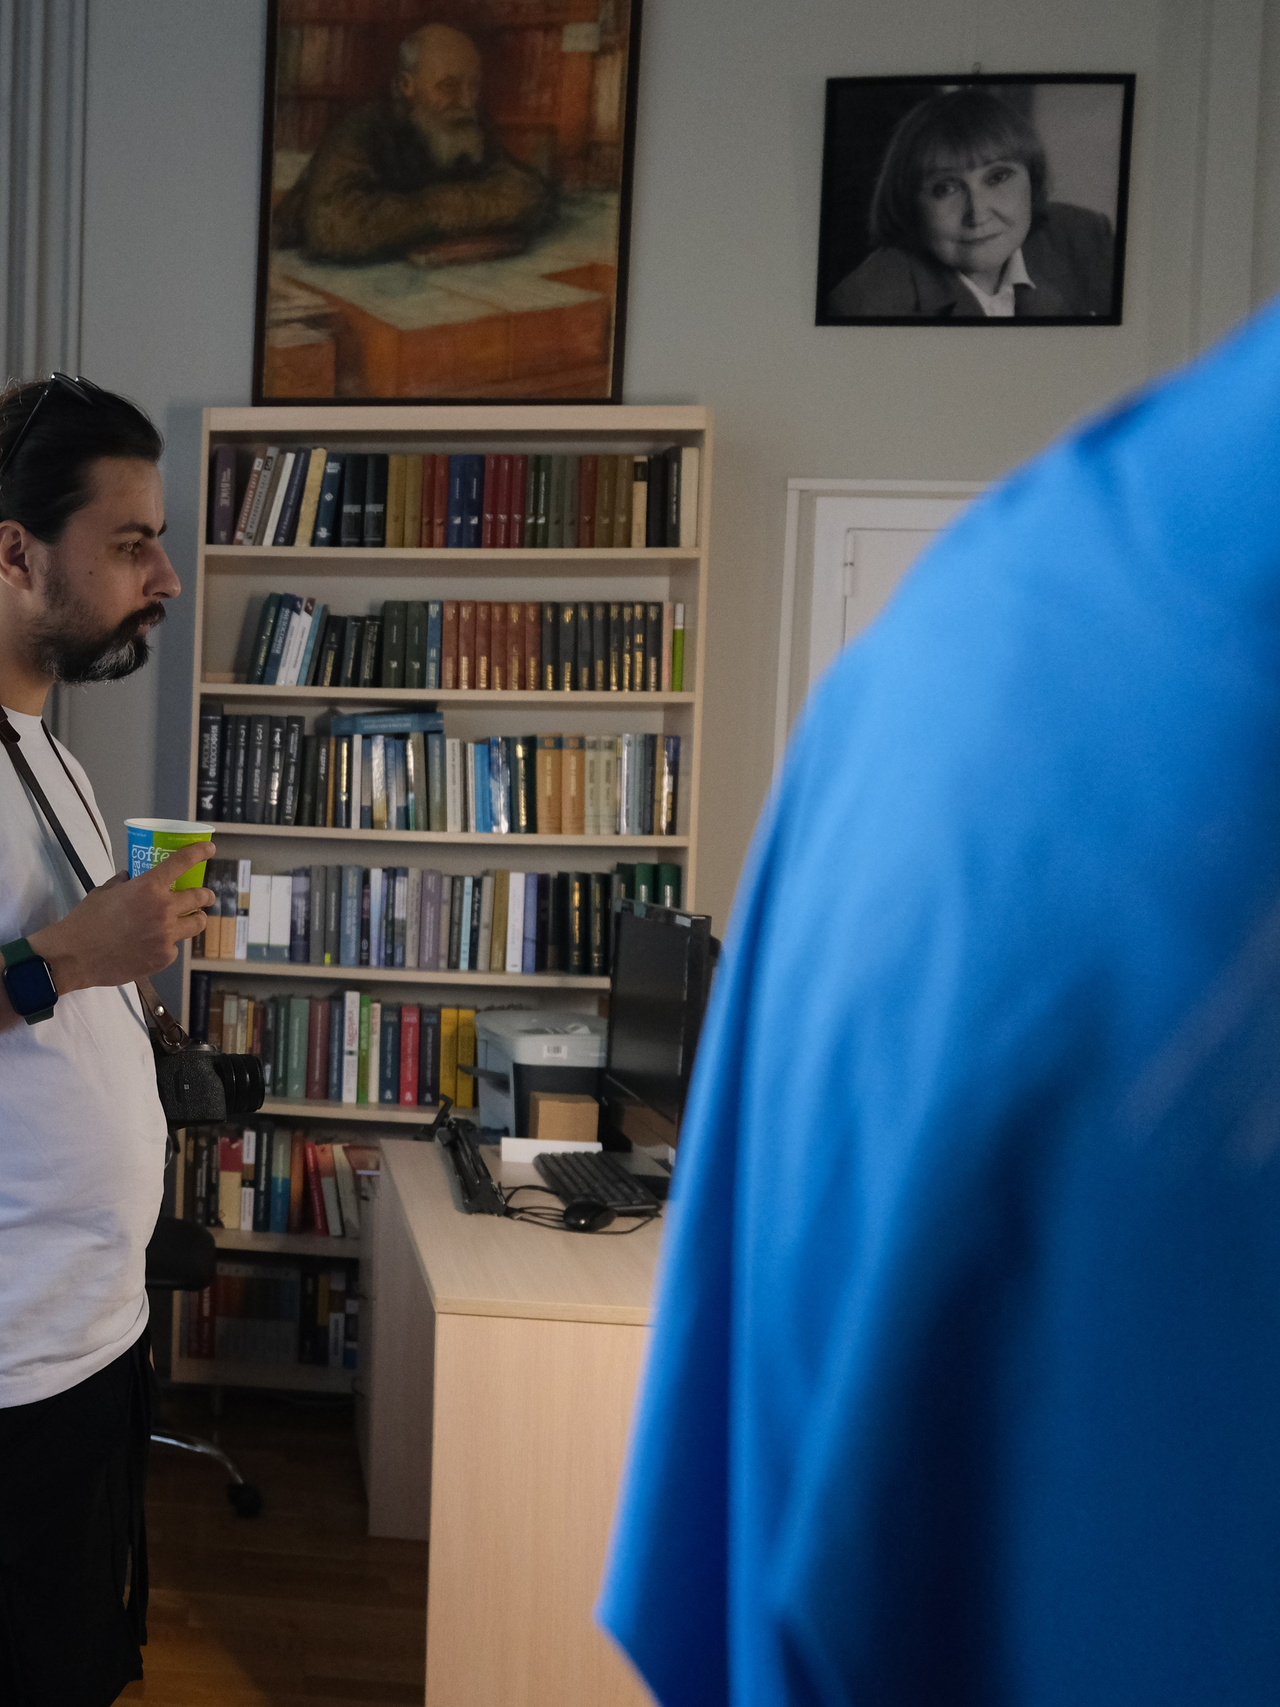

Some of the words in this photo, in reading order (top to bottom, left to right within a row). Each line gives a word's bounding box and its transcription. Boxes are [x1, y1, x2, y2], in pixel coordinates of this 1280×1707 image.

[202, 733, 210, 768] РУССКАЯ
[209, 725, 218, 777] ФИЛОСОФИЯ
[132, 847, 170, 862] coffe
